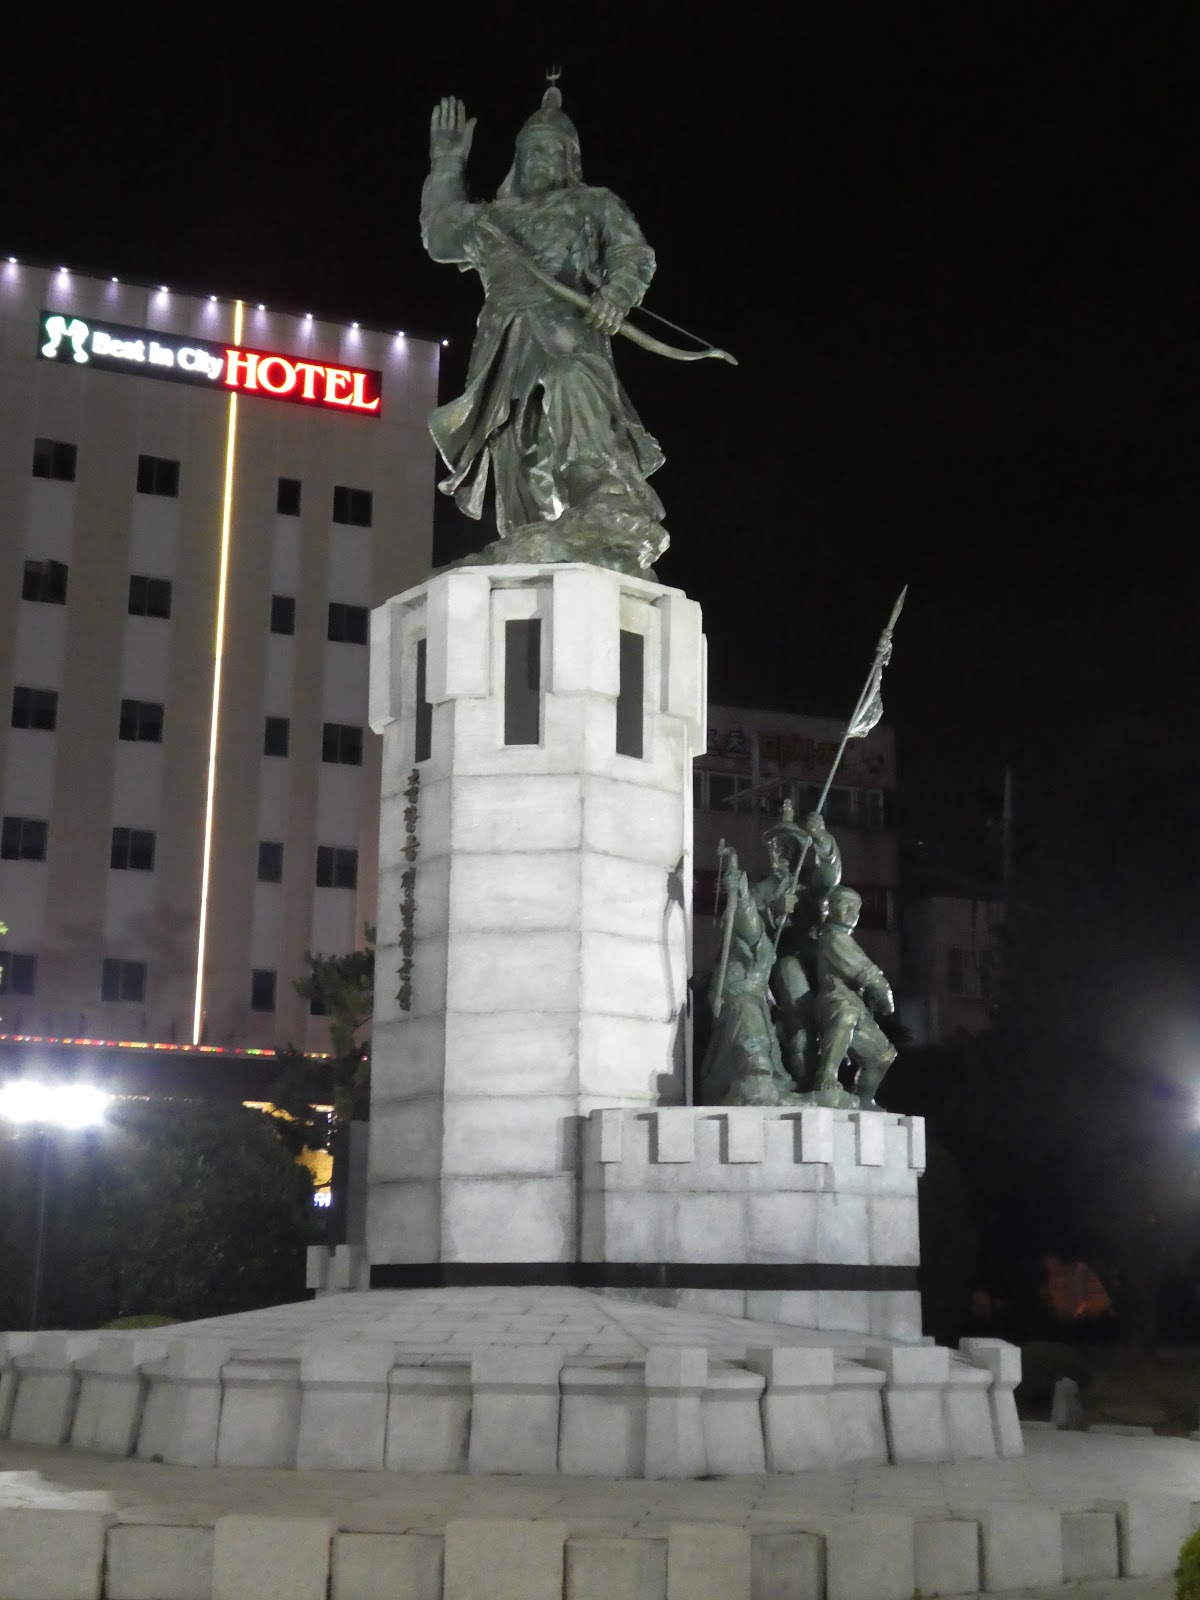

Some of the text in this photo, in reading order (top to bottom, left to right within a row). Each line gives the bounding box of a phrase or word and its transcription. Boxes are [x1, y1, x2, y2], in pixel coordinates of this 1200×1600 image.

[92, 331, 145, 362] Best
[177, 347, 224, 380] City
[225, 349, 379, 410] HOTEL
